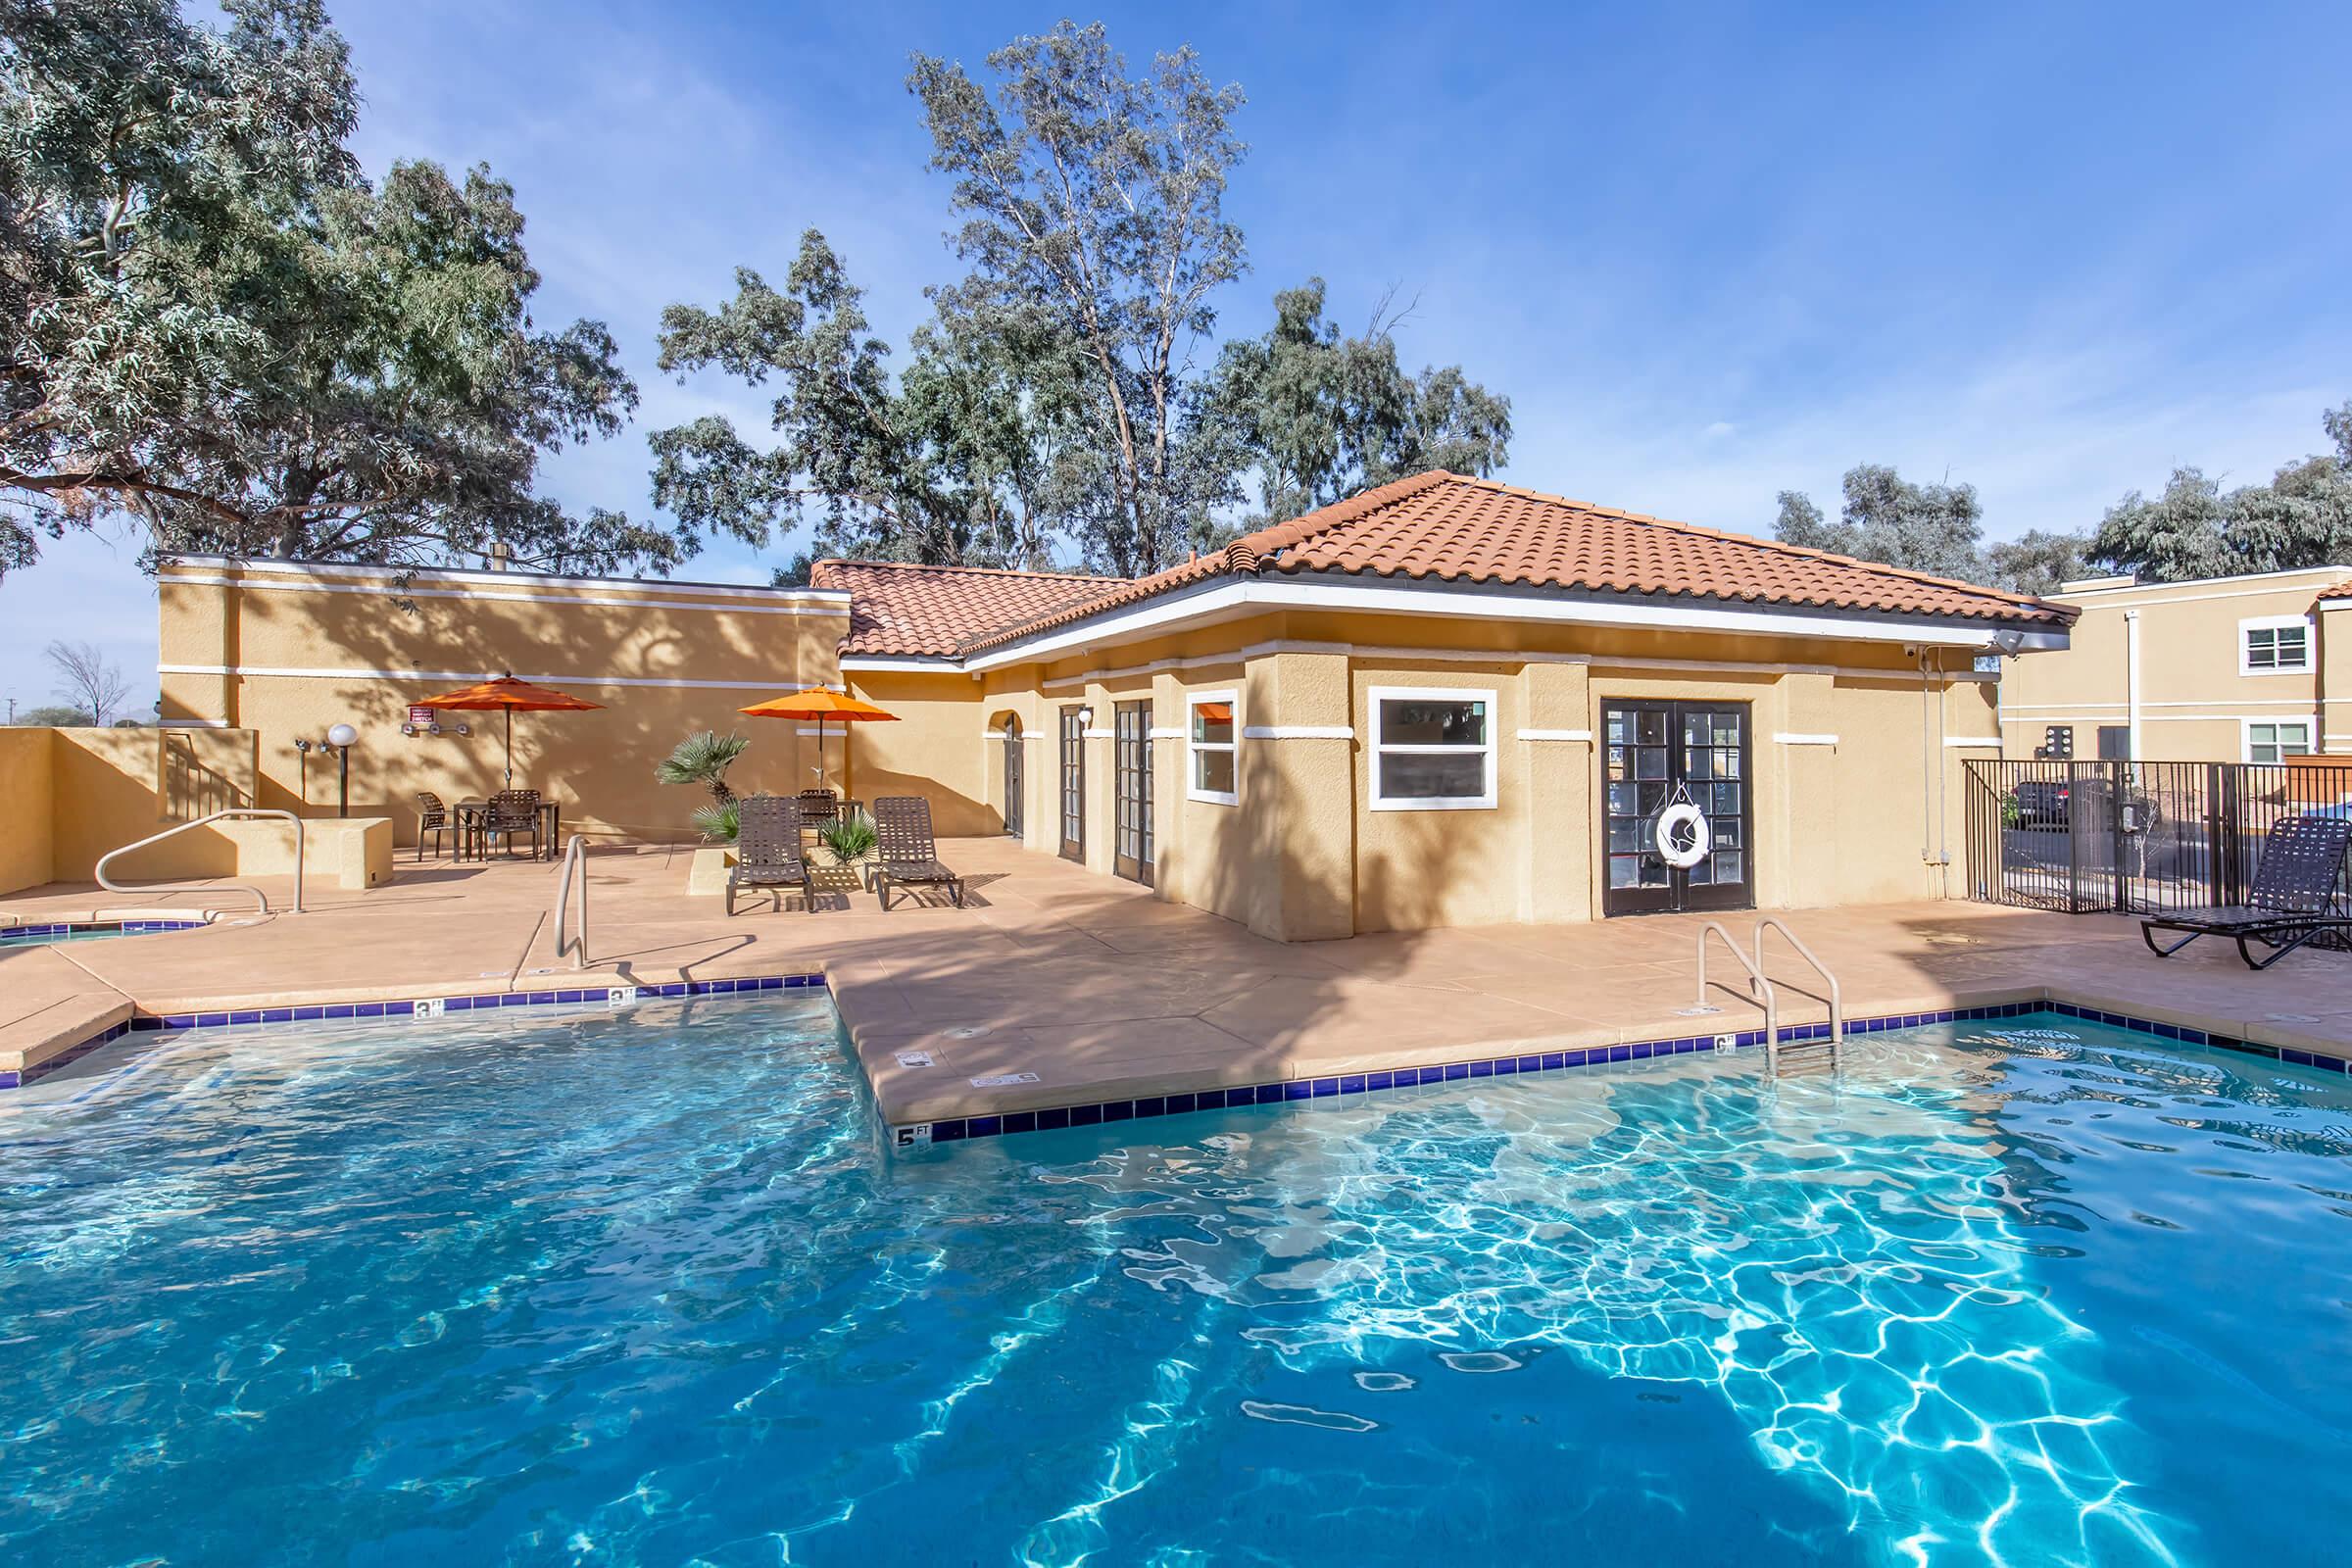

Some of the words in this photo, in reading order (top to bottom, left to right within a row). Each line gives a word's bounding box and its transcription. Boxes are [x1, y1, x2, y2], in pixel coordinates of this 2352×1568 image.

[416, 1002, 430, 1017] 3
[897, 1128, 915, 1147] 5
[916, 1125, 929, 1135] FT
